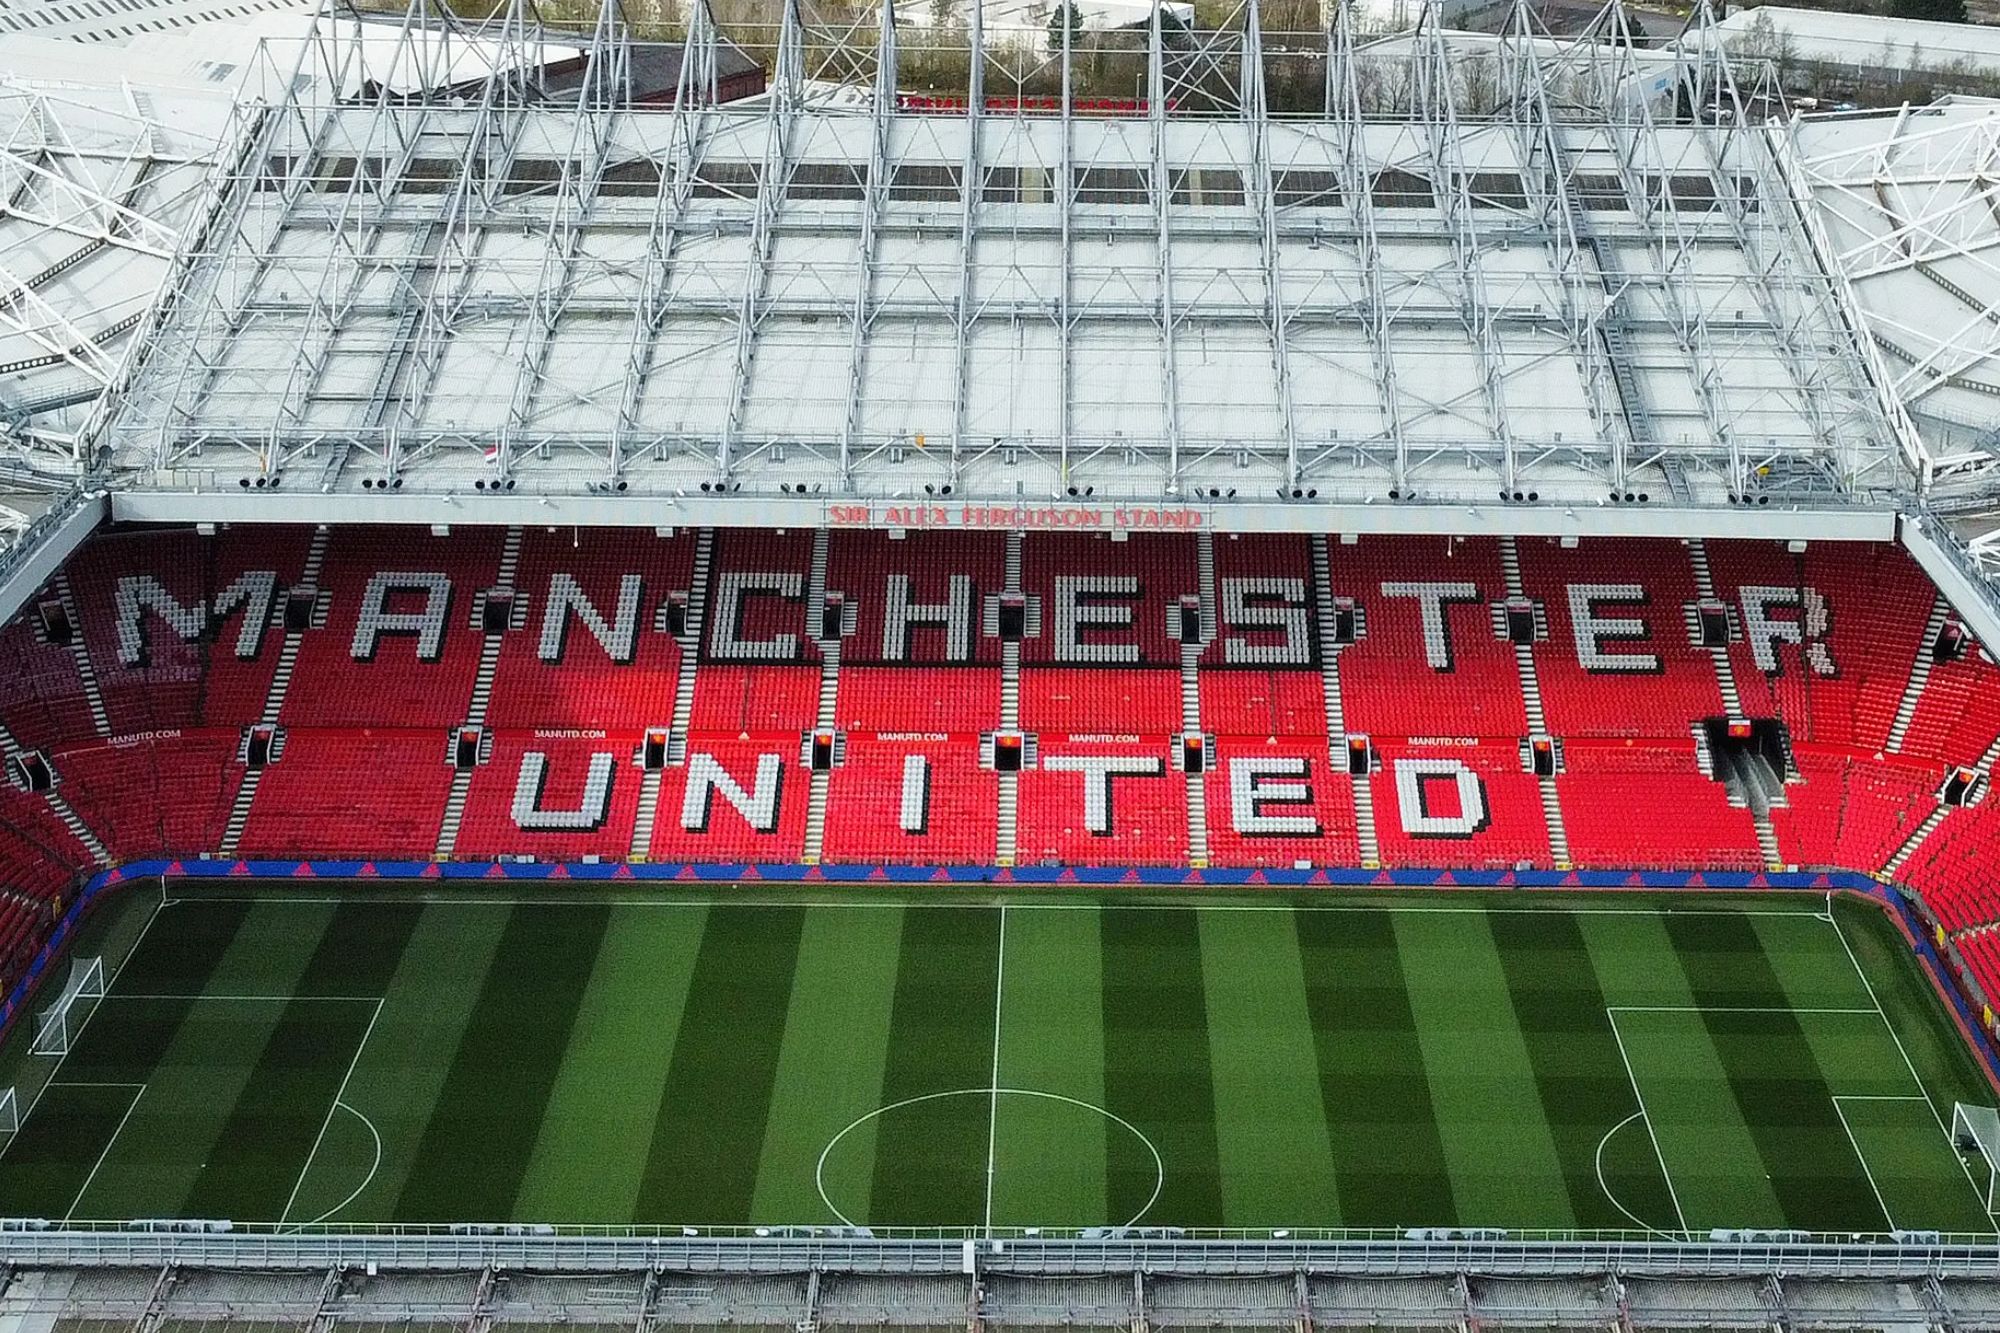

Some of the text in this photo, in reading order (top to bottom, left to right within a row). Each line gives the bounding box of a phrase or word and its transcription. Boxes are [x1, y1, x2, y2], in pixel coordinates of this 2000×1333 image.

[830, 505, 1202, 527] SIR ALEX FERGUSON STAND
[115, 570, 1838, 676] MANCHESTER
[106, 729, 181, 745] MANUTD.COM
[534, 729, 605, 739] MANUTD.COM
[877, 732, 948, 742] MANUTD.COM
[1068, 734, 1139, 744] MANUTD.COM
[1407, 736, 1479, 746] MANUTD.COM
[511, 752, 1488, 838] UNITED
